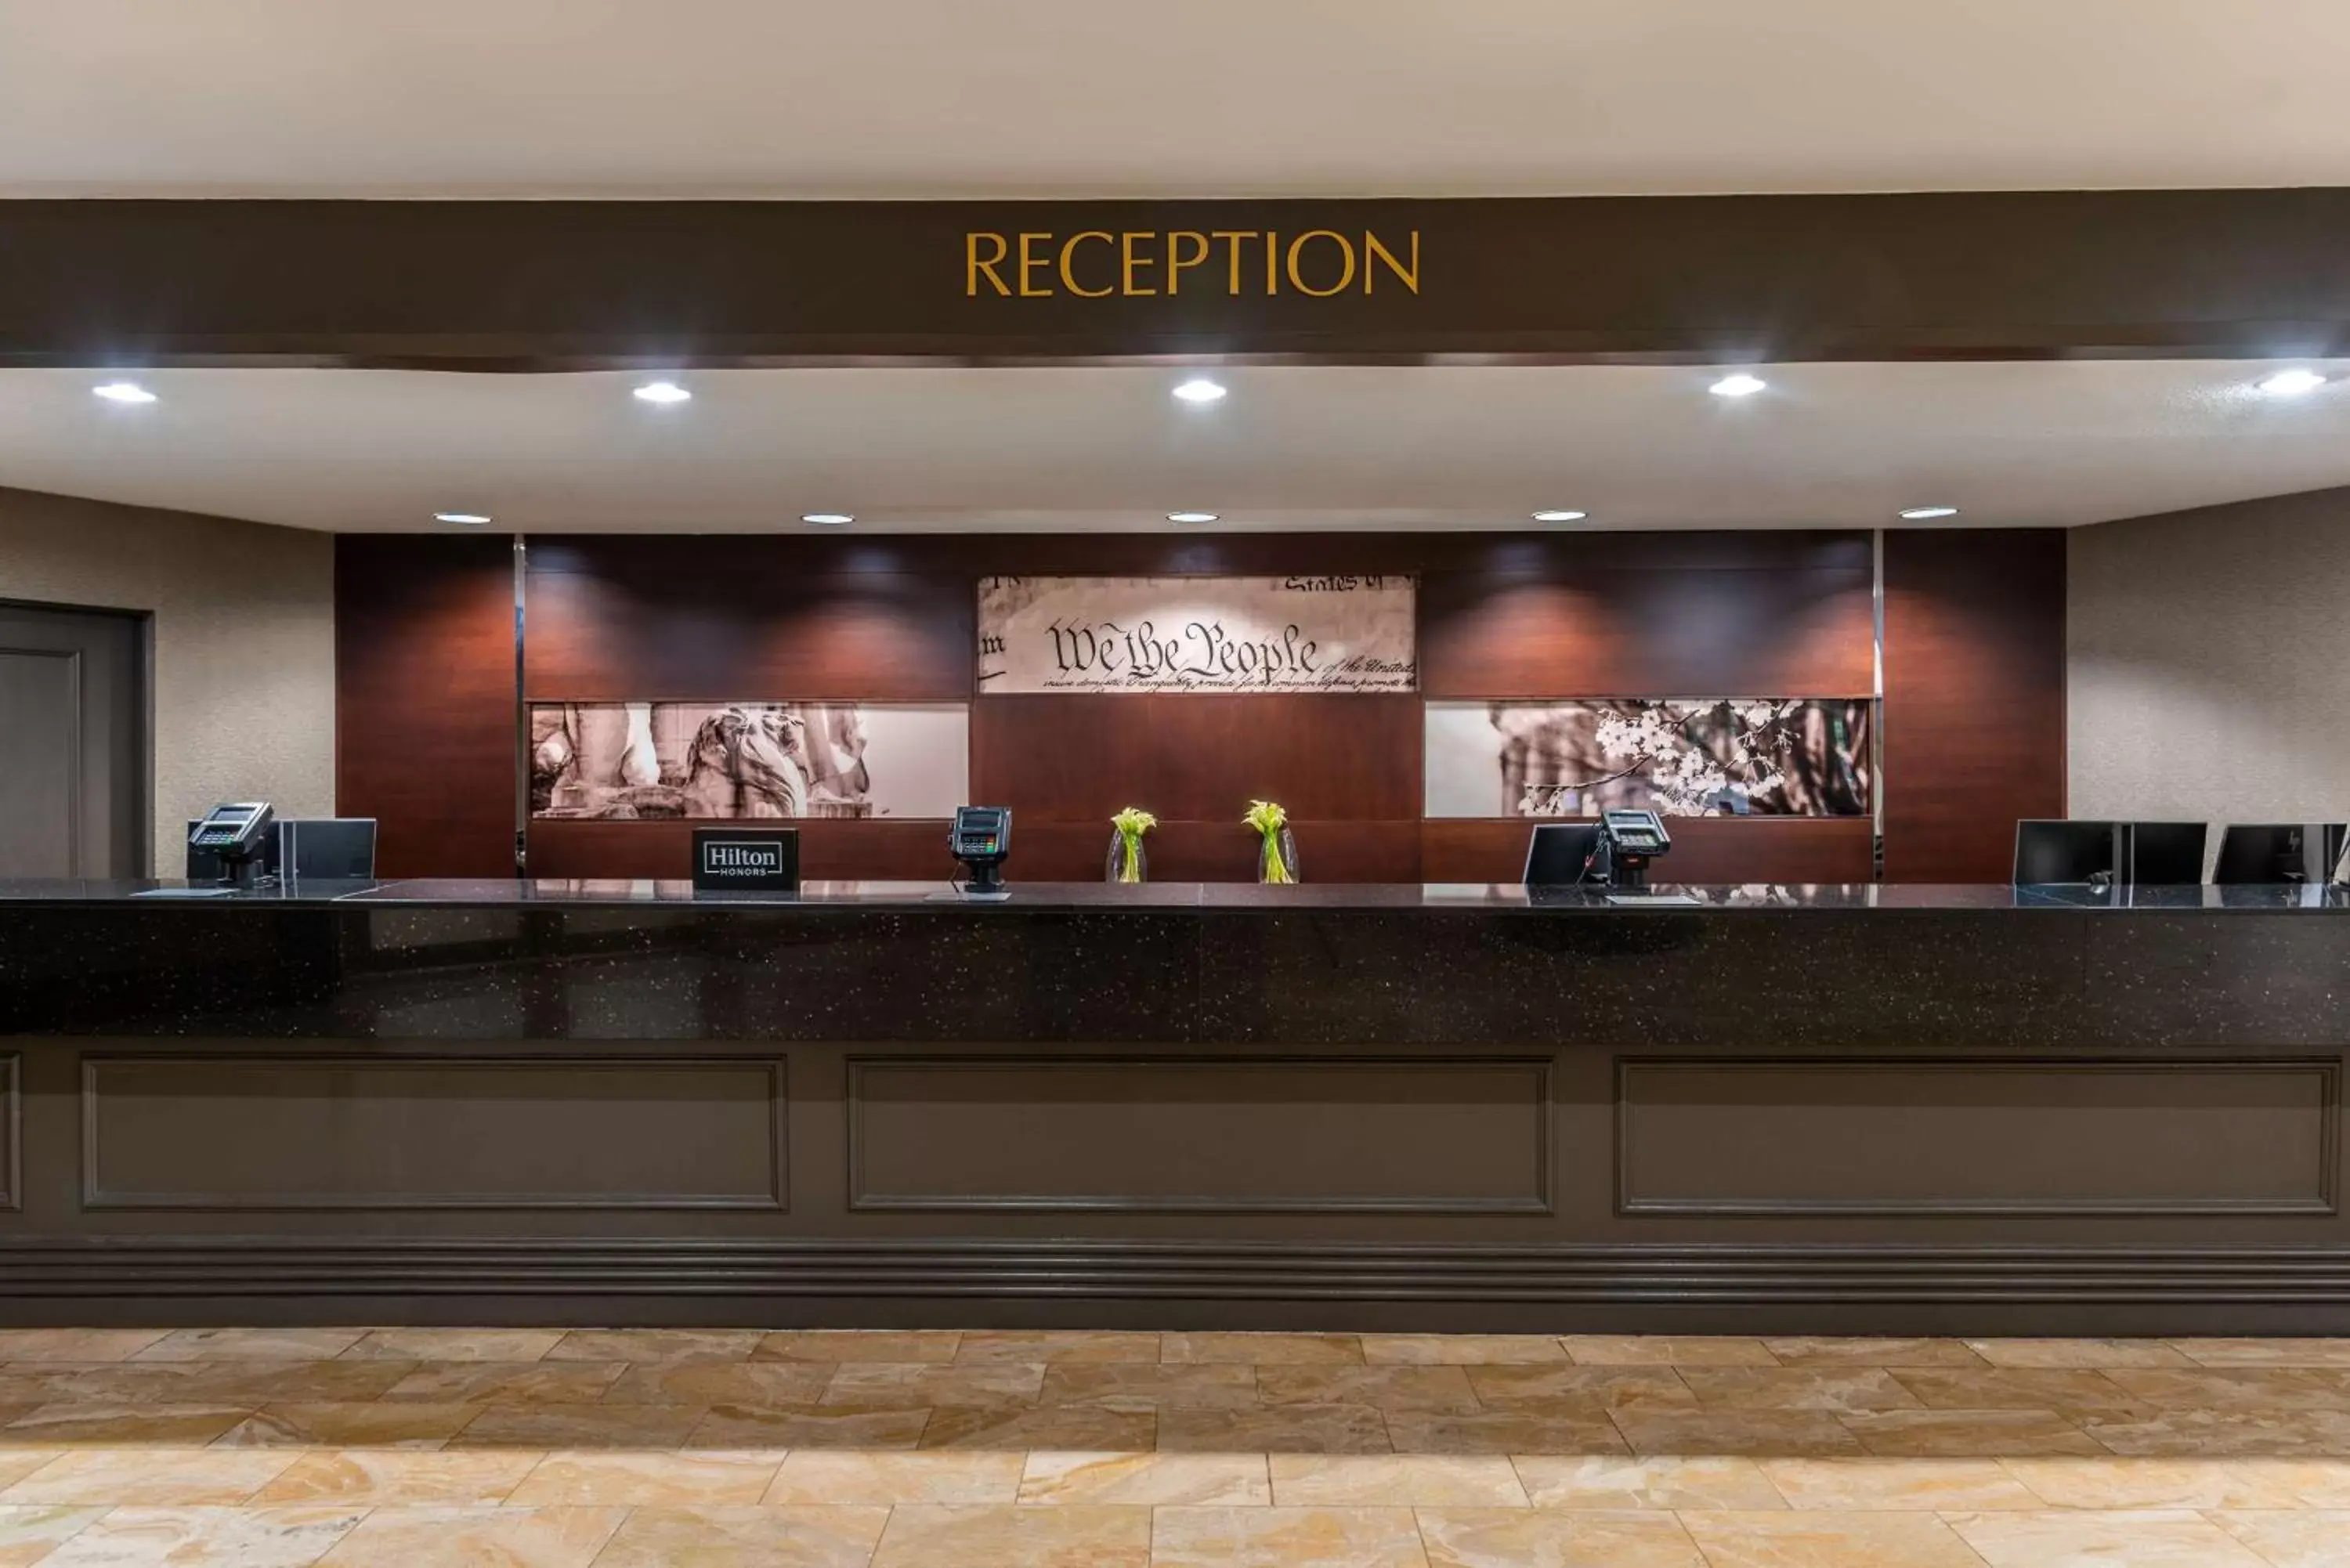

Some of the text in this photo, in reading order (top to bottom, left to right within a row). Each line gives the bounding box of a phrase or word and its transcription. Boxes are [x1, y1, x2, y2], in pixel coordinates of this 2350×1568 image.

[966, 229, 1419, 298] RECEPTION
[1044, 618, 1123, 674] We
[1125, 620, 1179, 678] the
[1179, 621, 1322, 685] People
[710, 847, 776, 866] Hilton
[720, 867, 767, 876] HONORS
